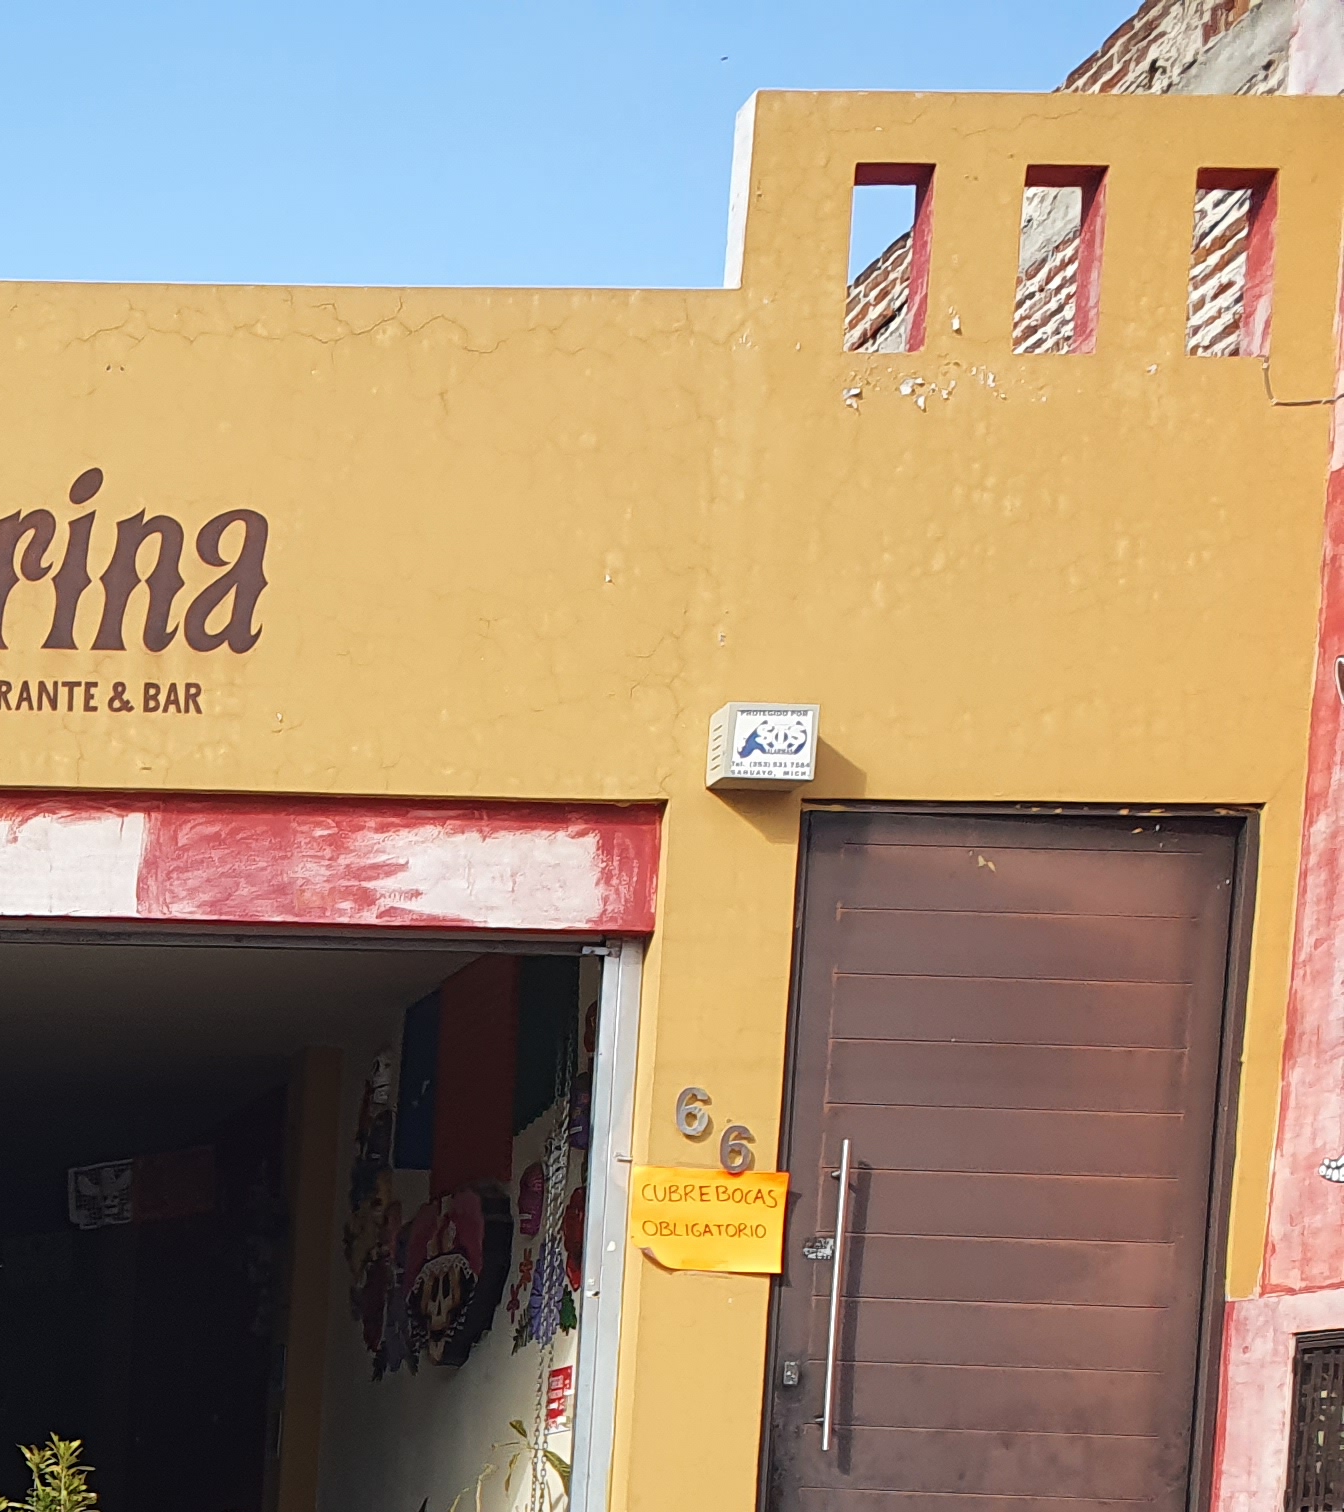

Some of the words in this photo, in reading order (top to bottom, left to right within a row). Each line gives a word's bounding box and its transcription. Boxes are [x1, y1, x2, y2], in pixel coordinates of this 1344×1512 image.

[108, 682, 134, 713] &
[142, 682, 204, 715] BAR
[641, 1183, 778, 1208] CUBREBOCAS
[642, 1220, 767, 1239] OBLIGATORIO
